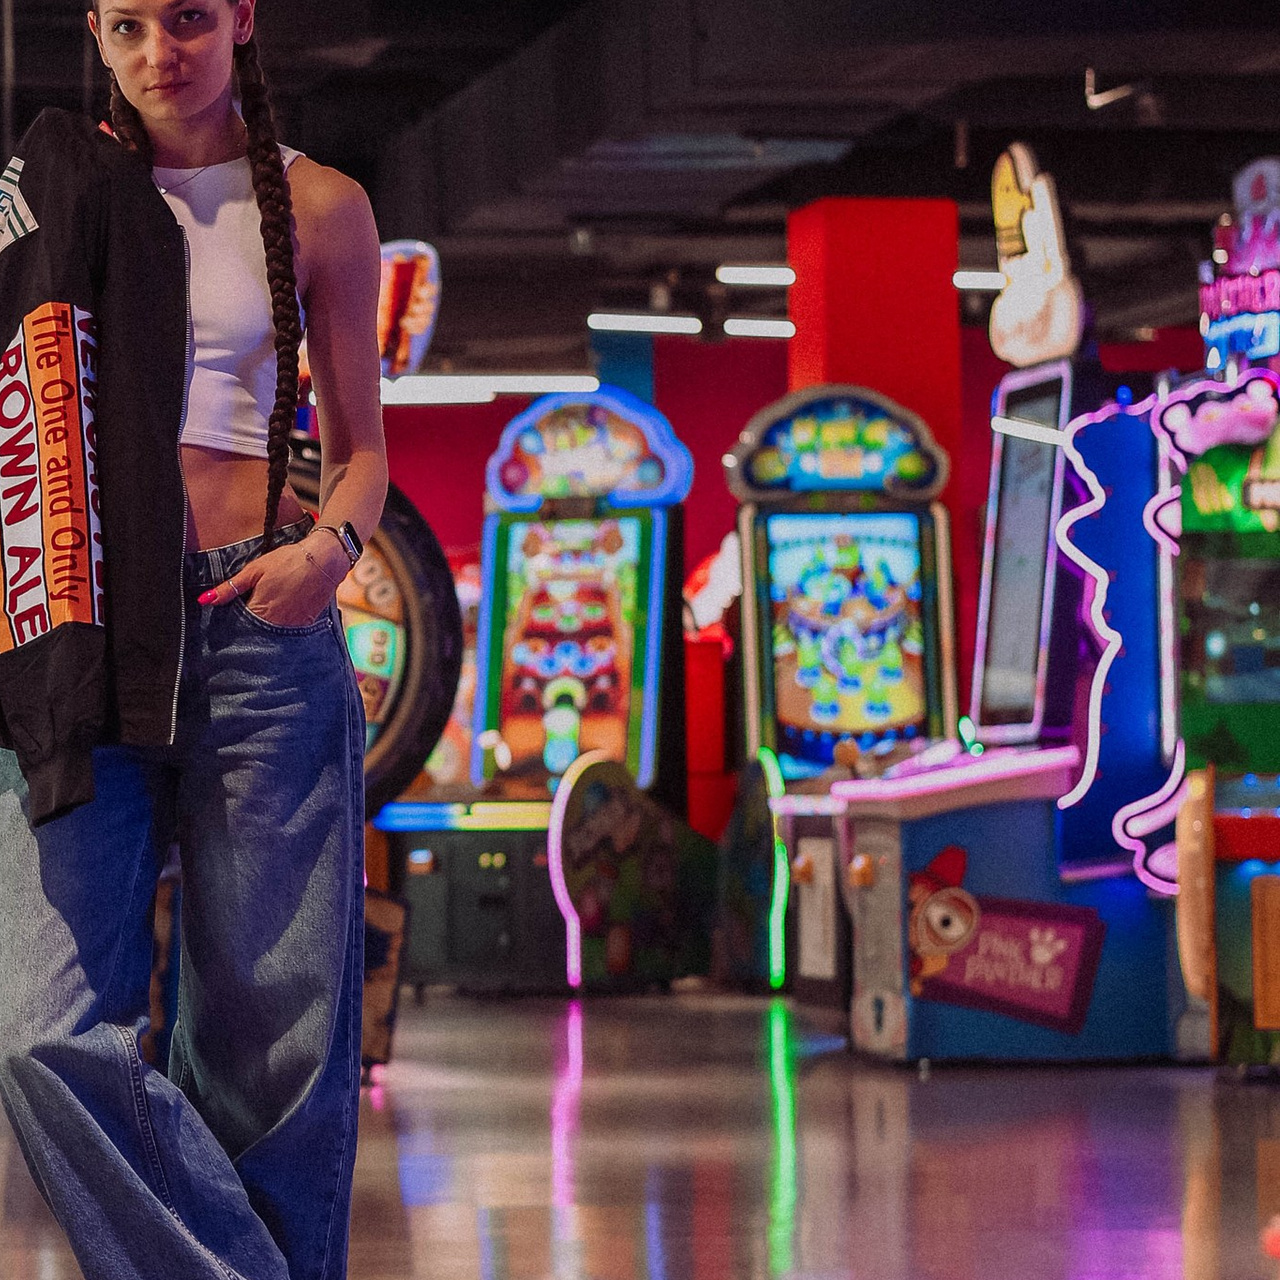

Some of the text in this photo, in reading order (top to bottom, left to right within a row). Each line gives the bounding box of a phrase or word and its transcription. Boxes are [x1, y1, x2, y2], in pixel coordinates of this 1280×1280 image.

[32, 310, 87, 604] The One and Only
[7, 545, 49, 644] ALE
